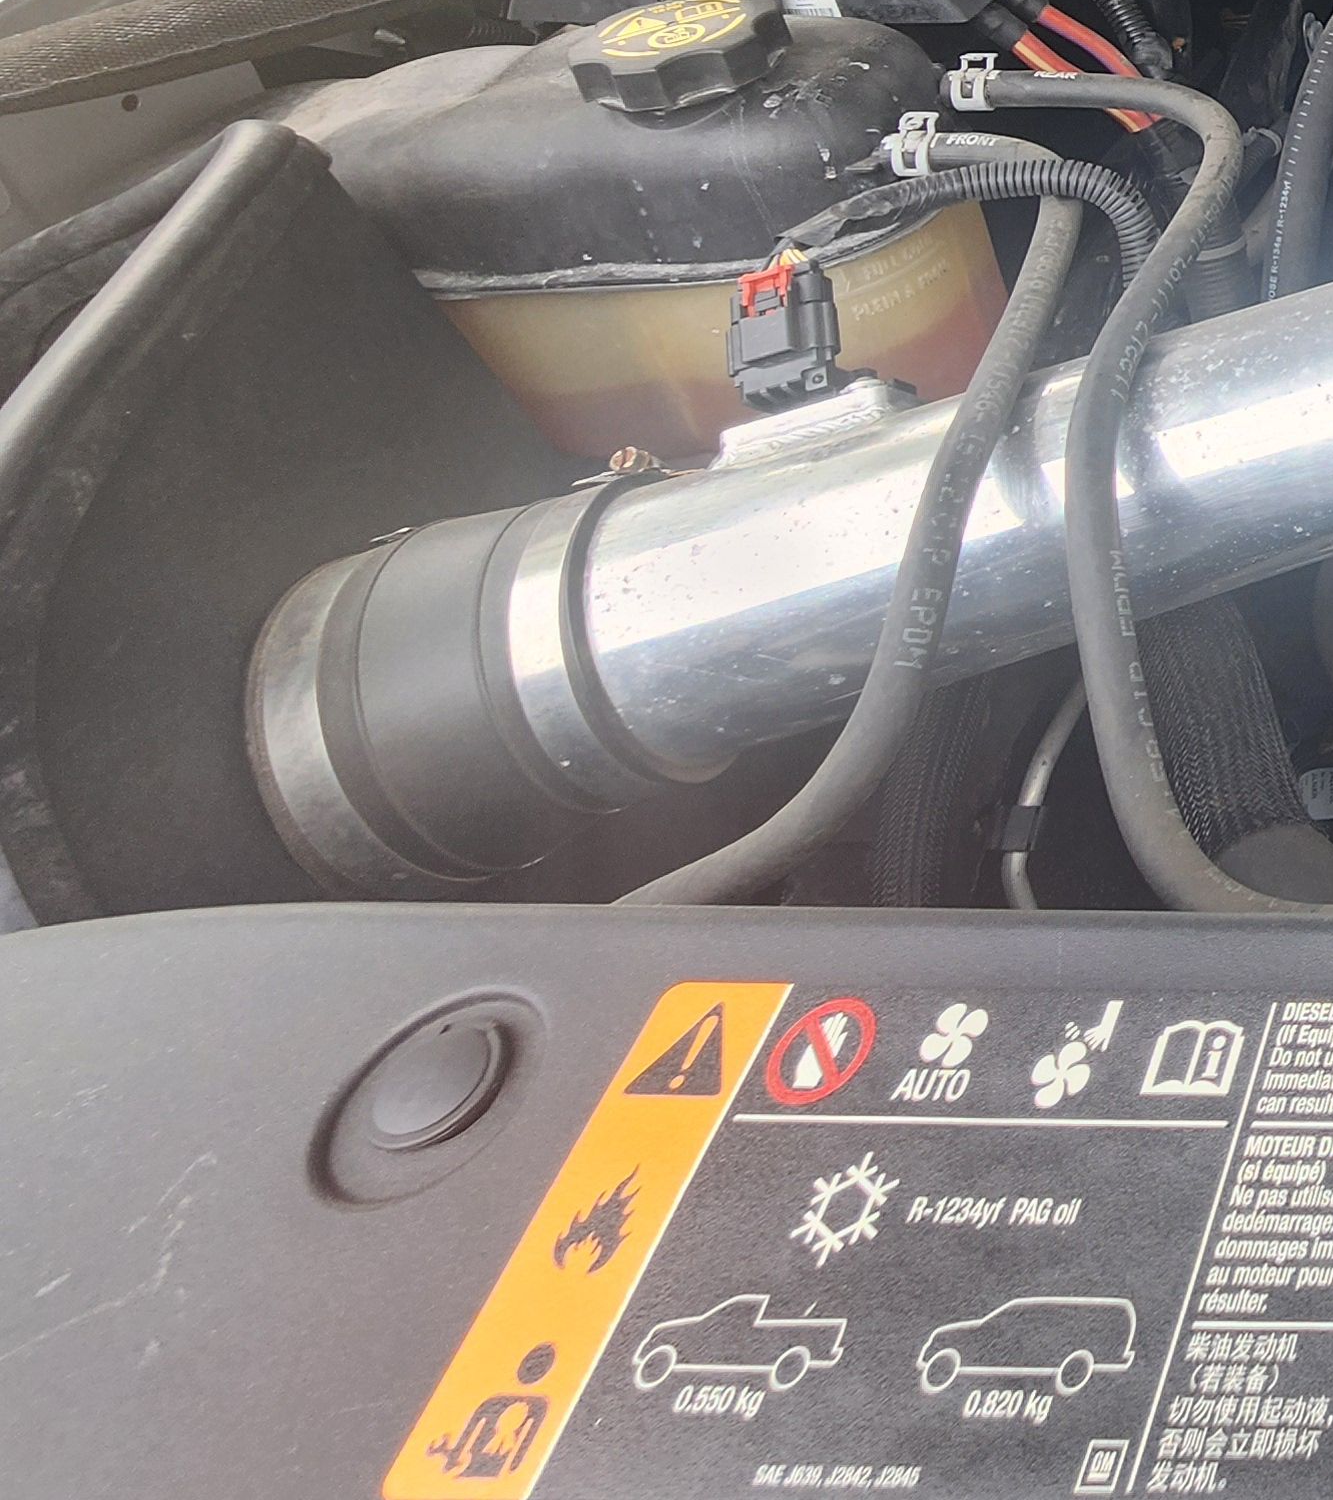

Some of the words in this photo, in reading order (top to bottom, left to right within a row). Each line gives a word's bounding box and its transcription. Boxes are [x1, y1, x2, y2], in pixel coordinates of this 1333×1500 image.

[945, 134, 1001, 147] FRONT
[1268, 275, 1278, 300] OSE
[1277, 180, 1292, 228] R-1234yf
[1275, 1025, 1298, 1047] (If
[1269, 1048, 1292, 1067] Do
[1294, 1048, 1323, 1068] not
[889, 1068, 971, 1102] AUTO
[1256, 1096, 1285, 1114] can
[1243, 1135, 1317, 1157] MOTEUR
[1237, 1160, 1263, 1184] (si
[1262, 1160, 1327, 1186] équipé)
[905, 1196, 1007, 1230] R-1234yf
[1007, 1197, 1054, 1226] PAG
[1052, 1198, 1084, 1225] oil
[1228, 1185, 1255, 1207] Ne
[1256, 1188, 1288, 1212] pas
[1214, 1236, 1309, 1265] dommages
[1205, 1266, 1229, 1286] au
[1231, 1263, 1296, 1286] moteur
[1198, 1289, 1269, 1314] résulter.
[1184, 1331, 1298, 1362] 柴油发动机
[672, 1385, 734, 1417] 0.550
[733, 1387, 767, 1420] kg
[961, 1389, 1022, 1421] 0.820
[1022, 1392, 1054, 1426] kg
[1157, 1427, 1323, 1460] 否则会立即损坏
[752, 1464, 787, 1488] SAE
[783, 1464, 824, 1488] J639,
[823, 1464, 873, 1493] J2842,
[872, 1465, 922, 1488] J2845
[1146, 1459, 1228, 1494] 发动机。
